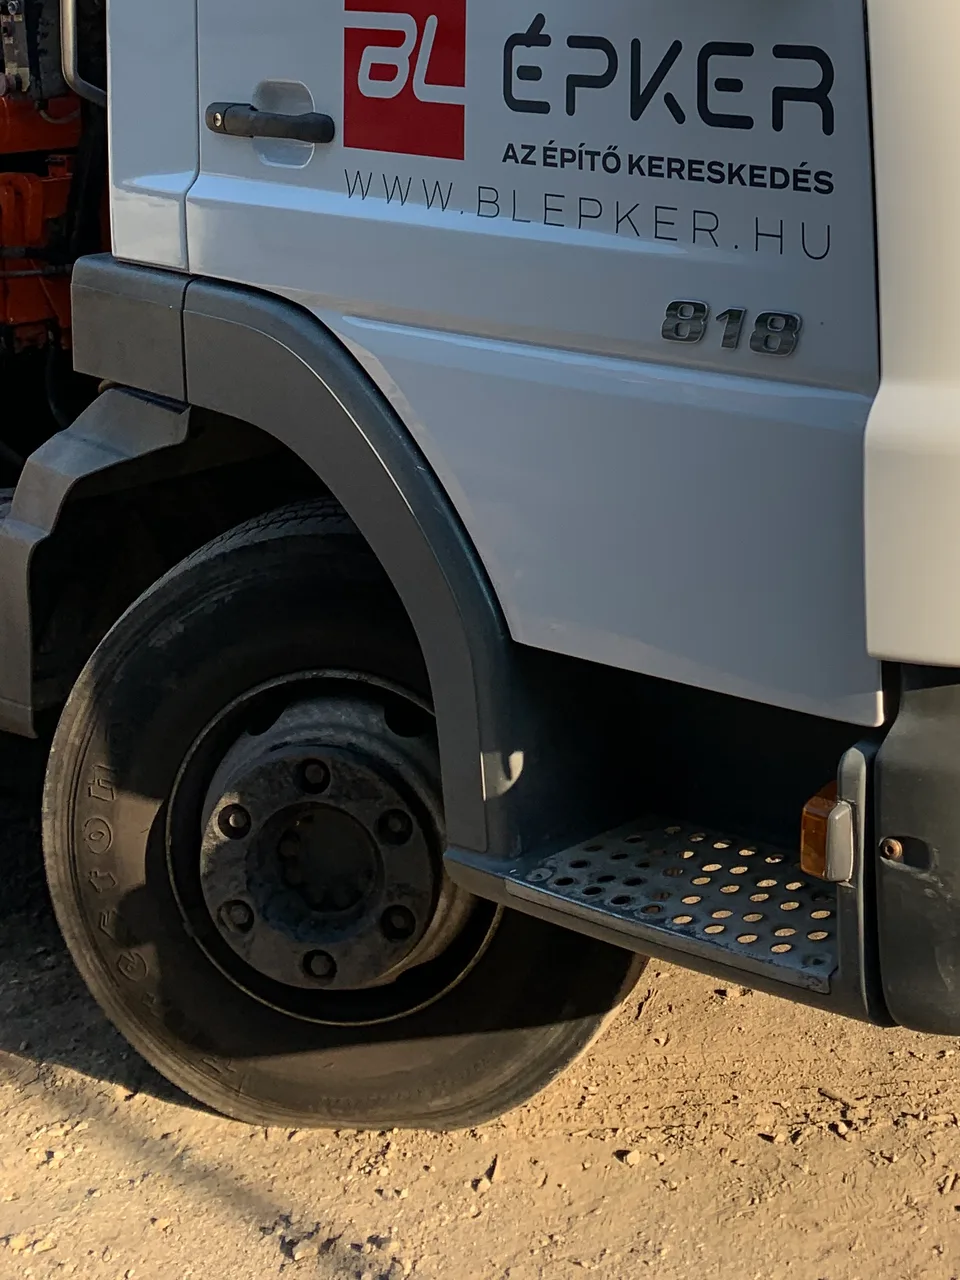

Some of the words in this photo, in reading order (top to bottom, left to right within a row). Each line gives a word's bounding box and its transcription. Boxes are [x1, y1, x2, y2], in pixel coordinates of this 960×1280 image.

[344, 10, 466, 105] BL
[503, 13, 835, 136] ÉPKER
[502, 143, 536, 166] AZ
[542, 140, 622, 174] ÉPÍTŐ
[628, 153, 835, 195] KERESKEDÉS
[344, 168, 832, 261] WWW.BLEPKER.HU
[661, 299, 803, 358] 818
